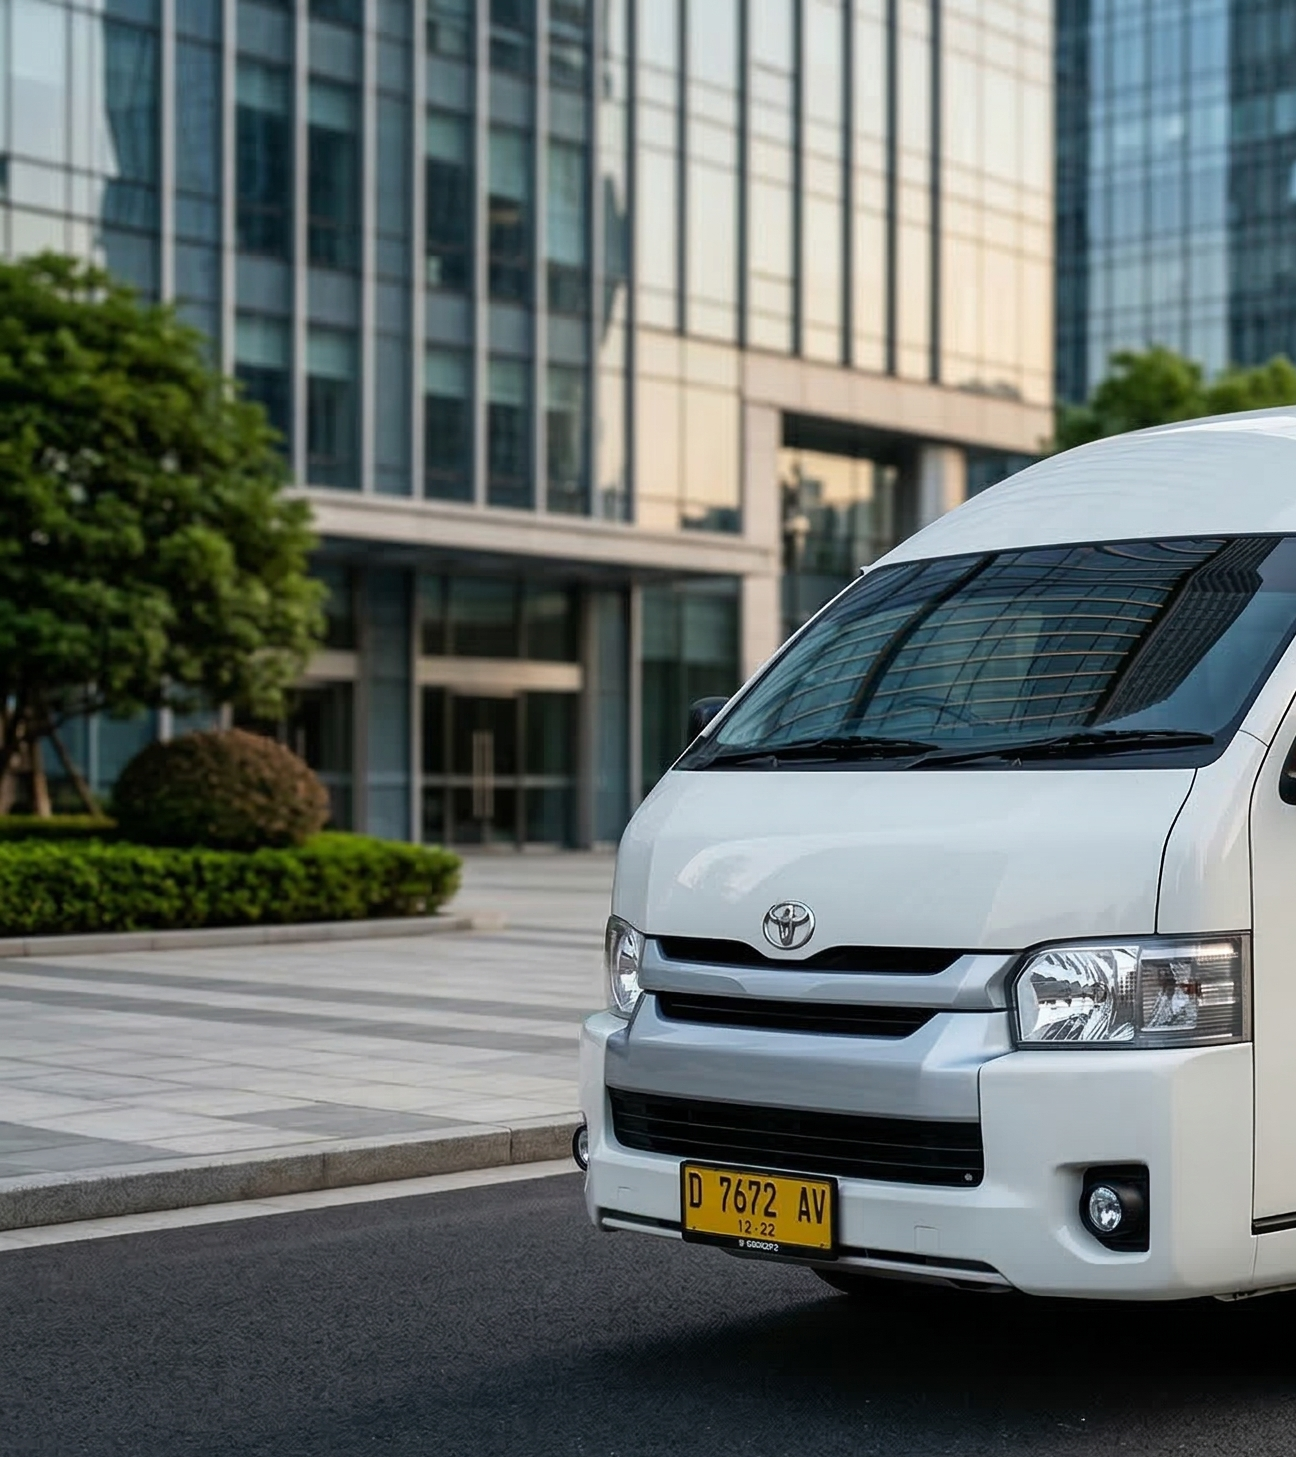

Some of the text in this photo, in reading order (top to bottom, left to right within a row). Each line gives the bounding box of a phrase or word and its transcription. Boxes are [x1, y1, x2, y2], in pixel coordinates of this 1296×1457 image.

[689, 1172, 826, 1224] D 7672 AV
